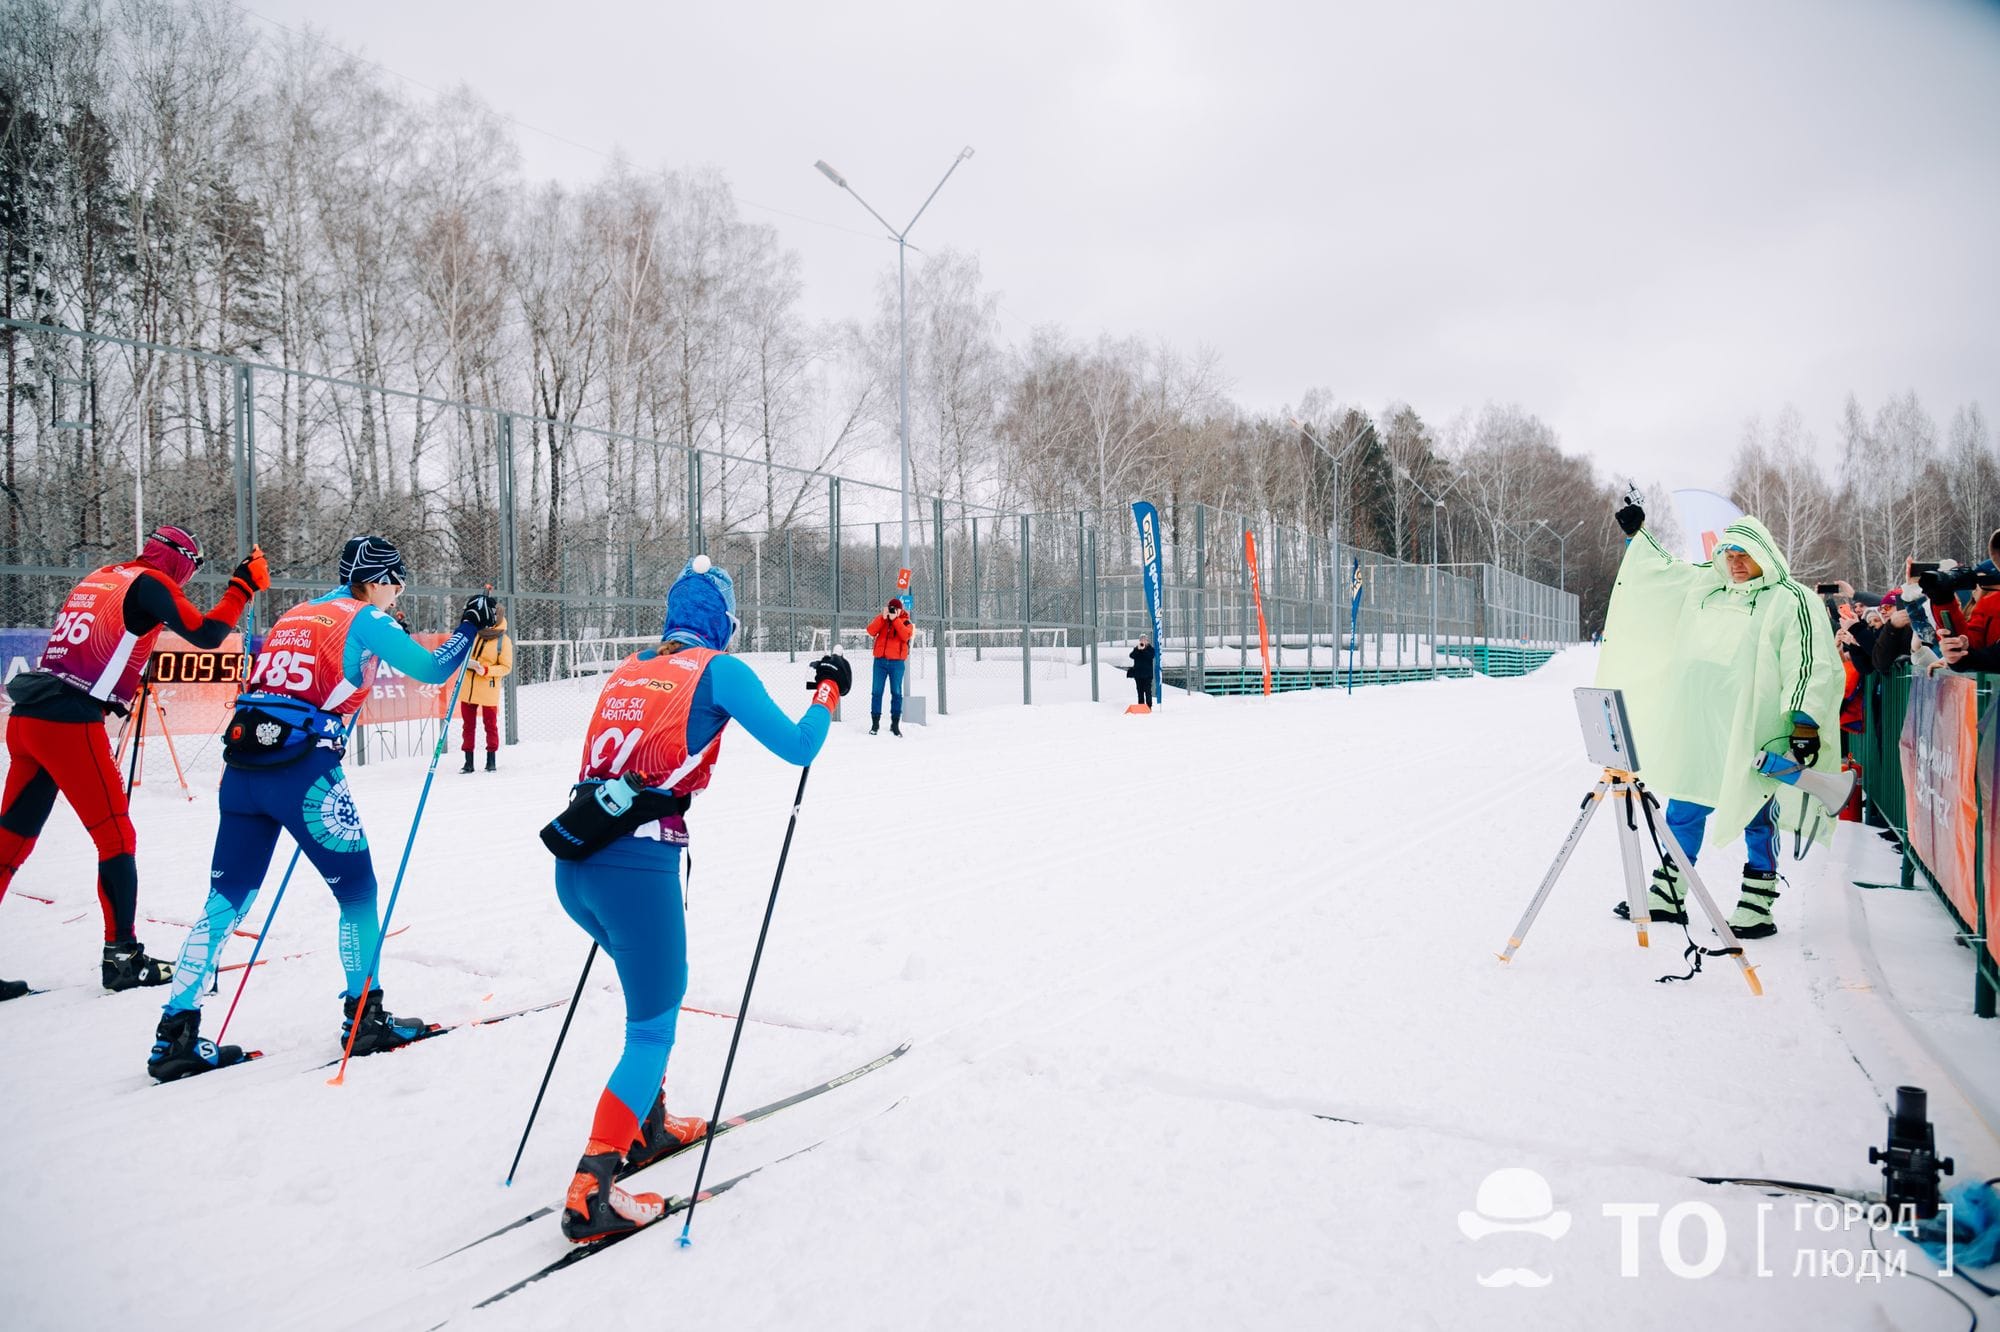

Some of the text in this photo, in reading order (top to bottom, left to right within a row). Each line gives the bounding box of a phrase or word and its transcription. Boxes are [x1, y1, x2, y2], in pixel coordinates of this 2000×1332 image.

[49, 611, 95, 645] 256
[250, 650, 316, 691] 185
[628, 698, 646, 709] SKI
